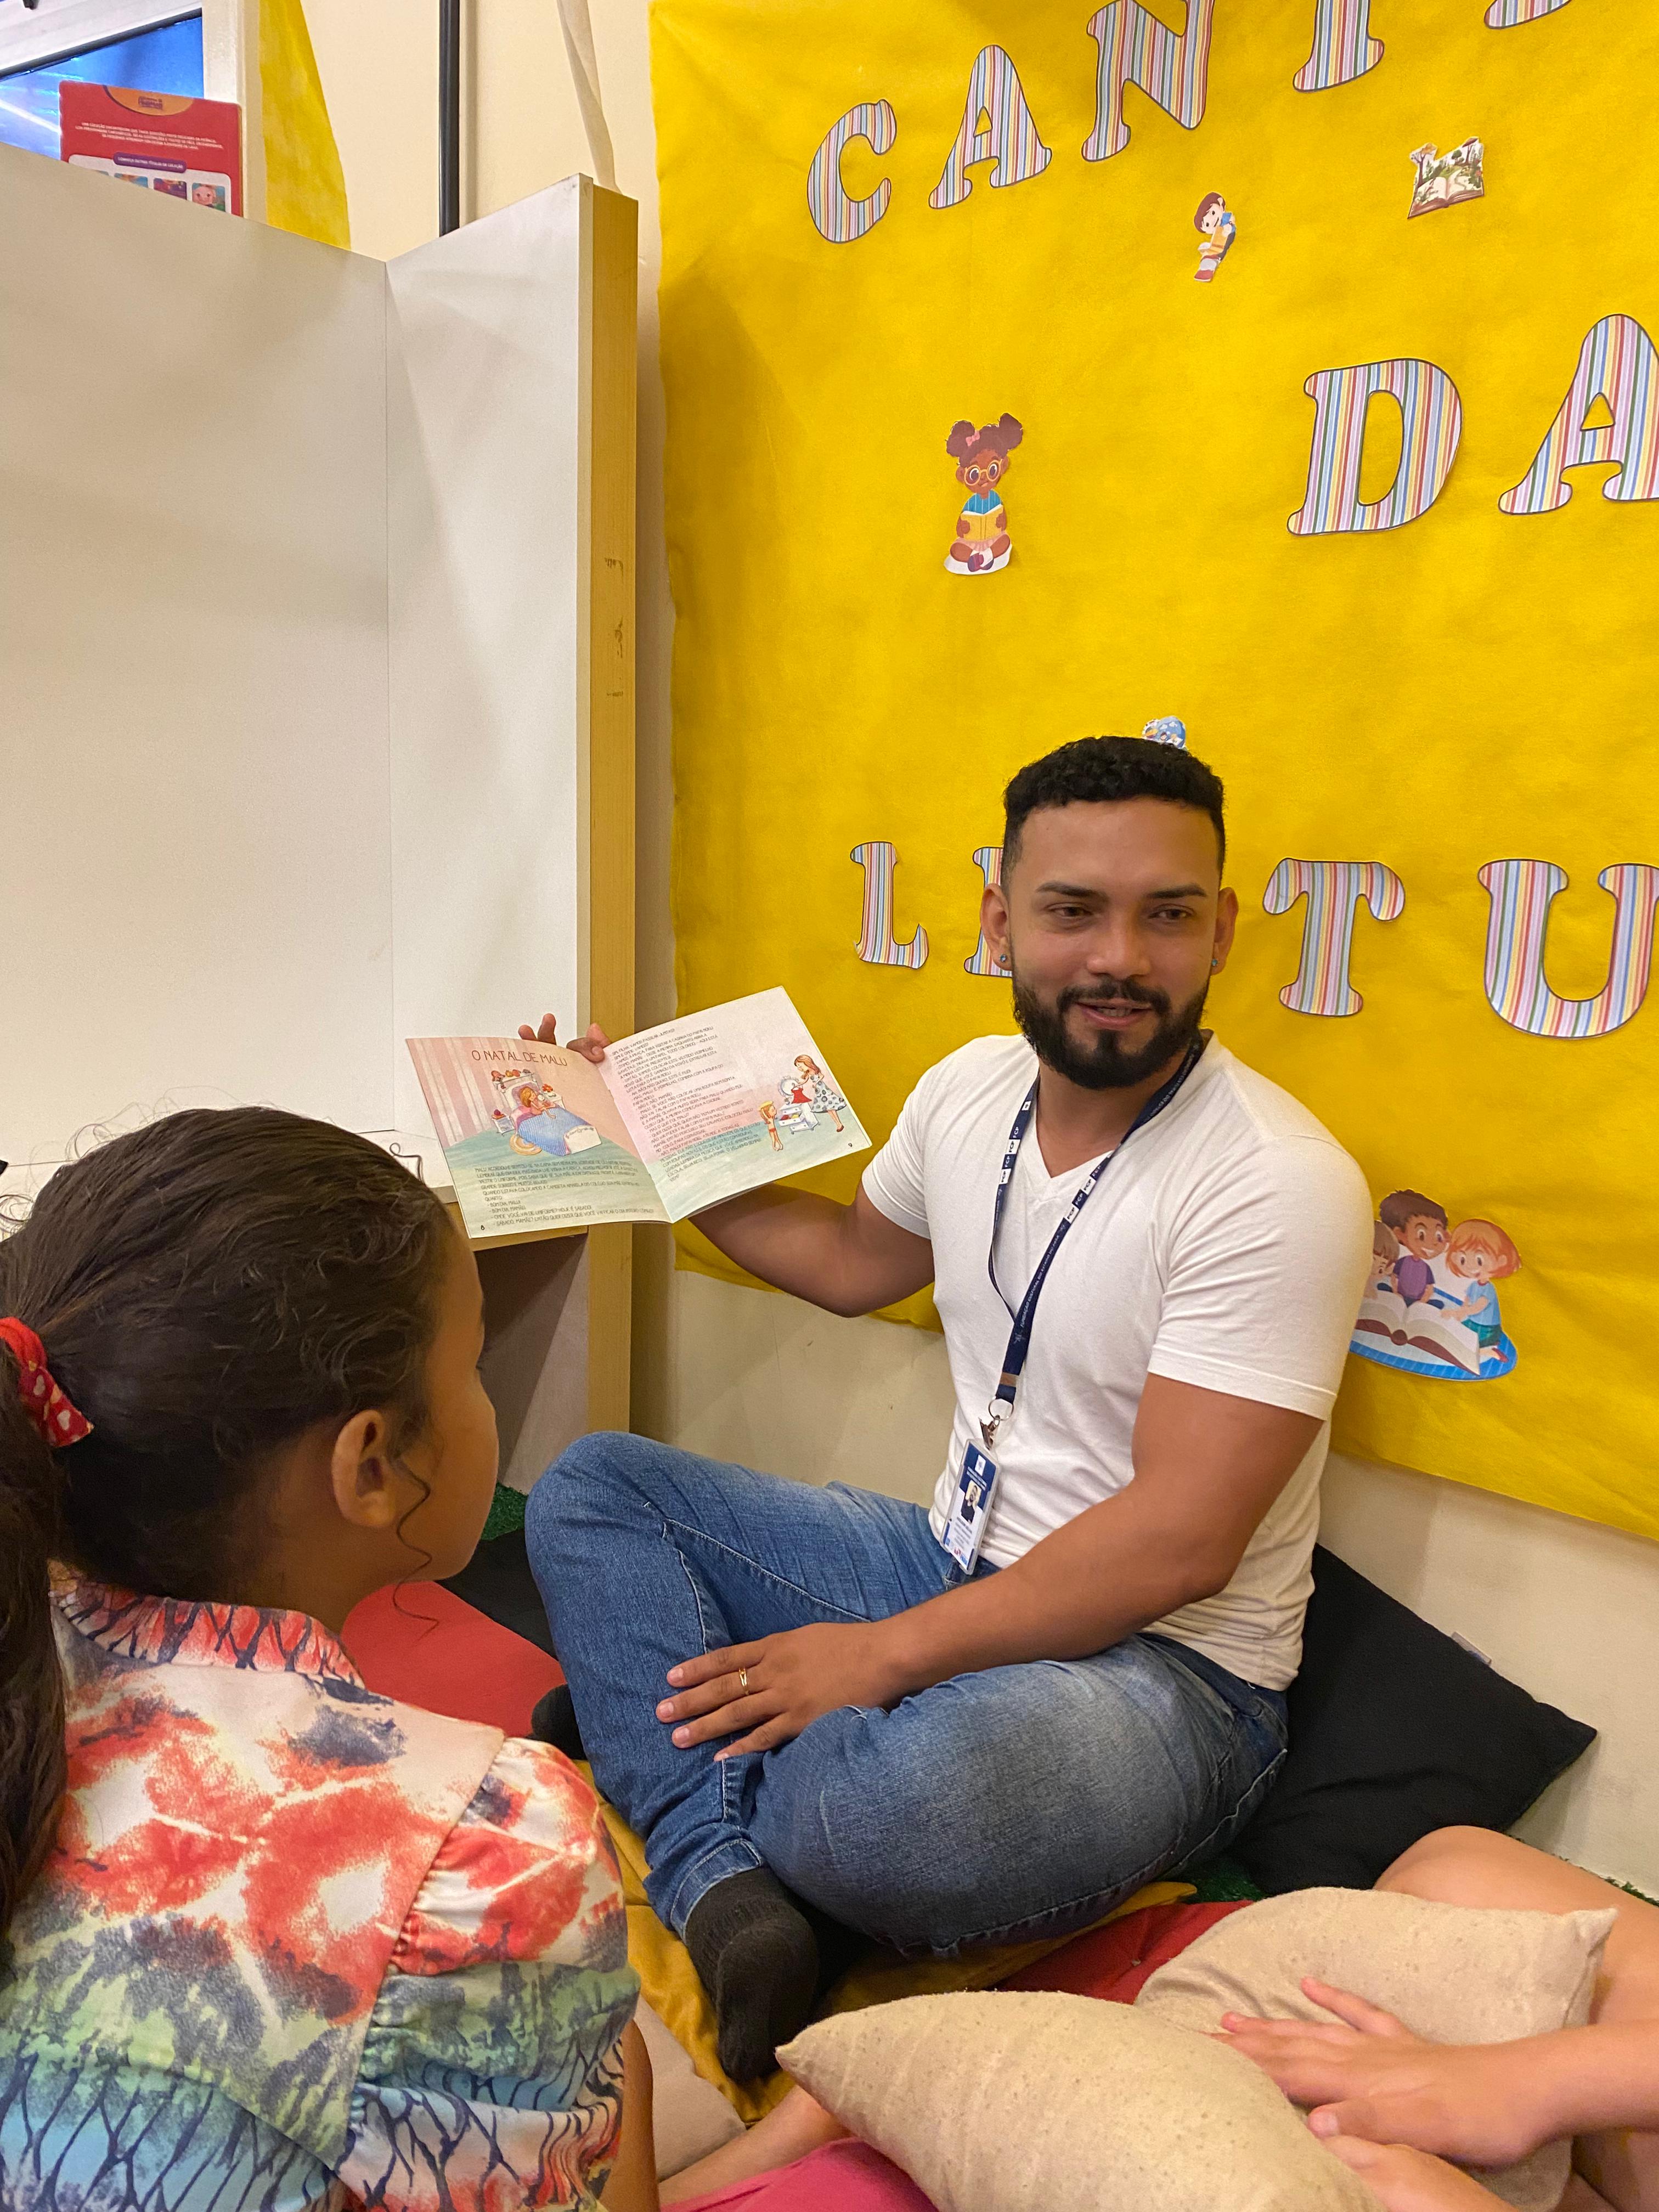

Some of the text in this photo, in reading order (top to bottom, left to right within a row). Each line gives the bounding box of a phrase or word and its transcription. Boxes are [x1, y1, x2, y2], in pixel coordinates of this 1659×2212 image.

[472, 1050, 567, 1066] O NATAL DE MALU
